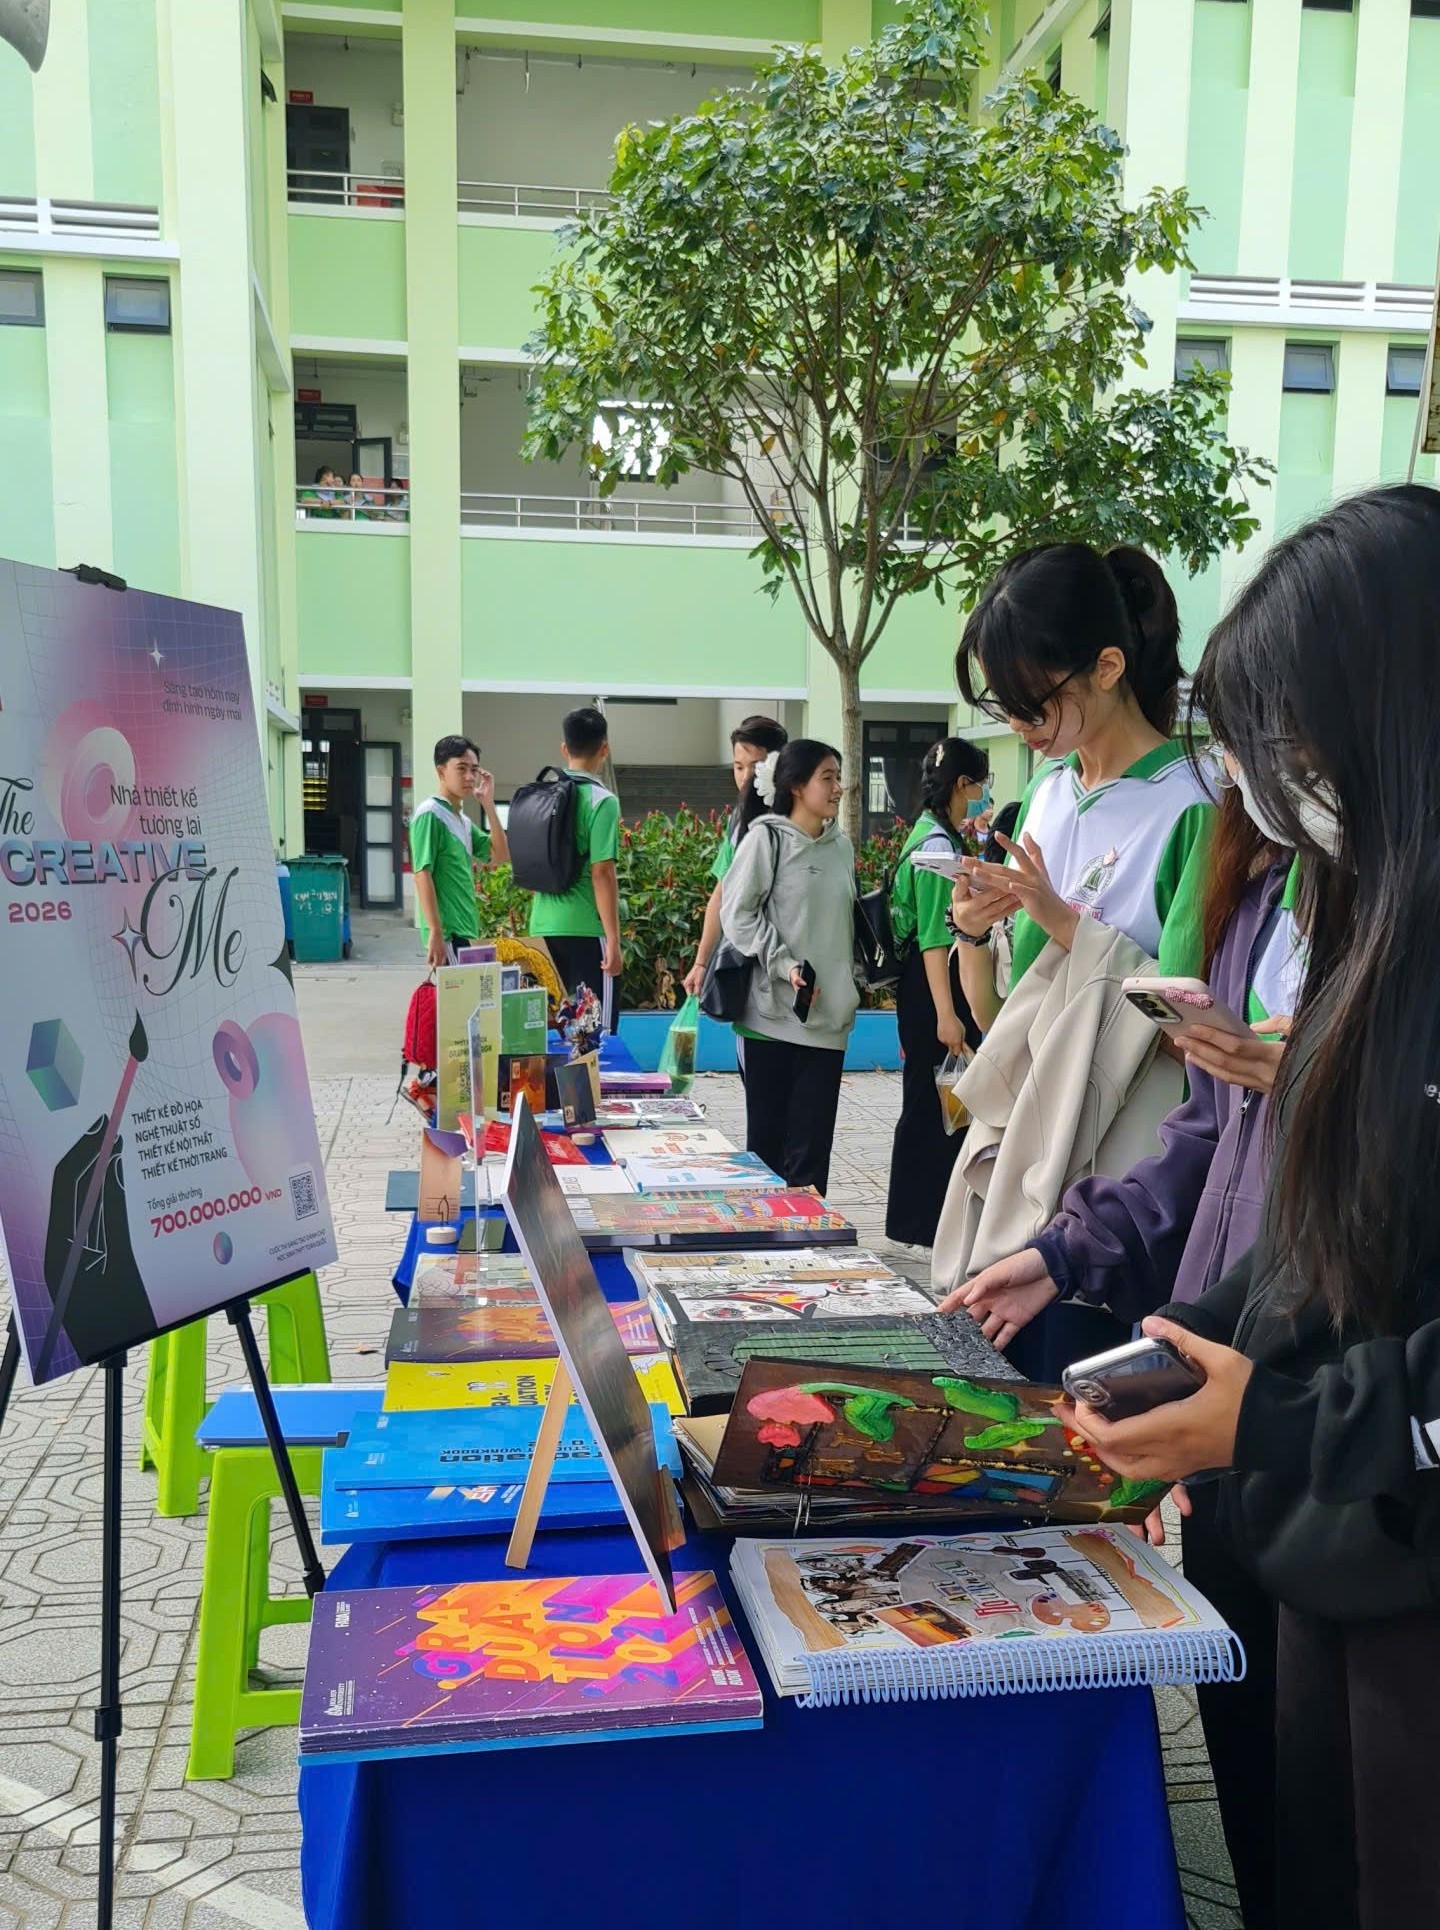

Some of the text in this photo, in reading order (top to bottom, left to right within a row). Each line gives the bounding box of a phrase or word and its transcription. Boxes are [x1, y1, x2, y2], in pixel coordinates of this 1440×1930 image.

[110, 783, 198, 808] Nhà thiết kế
[186, 815, 202, 835] lai
[0, 840, 210, 887] CREATIVE
[8, 900, 73, 924] 2026
[140, 866, 247, 996] Me
[131, 1107, 157, 1126] THIẾT
[157, 1103, 170, 1120] KẾ
[170, 1100, 184, 1116] ĐỒ
[135, 1113, 202, 1144] NGHỆ THUẬT SỐ
[138, 1131, 213, 1162] THIẾT KẾ NỘI THẤT
[141, 1161, 166, 1180] THIẾT
[167, 1157, 179, 1174] KẾ
[199, 1147, 228, 1165] TRANG
[150, 1186, 262, 1238] 700.000.000
[516, 1374, 538, 1406] UATION
[542, 1600, 609, 1684] TION
[606, 1607, 681, 1687] 2021
[710, 1669, 728, 1686] WORK
[725, 1669, 744, 1686] BOOK
